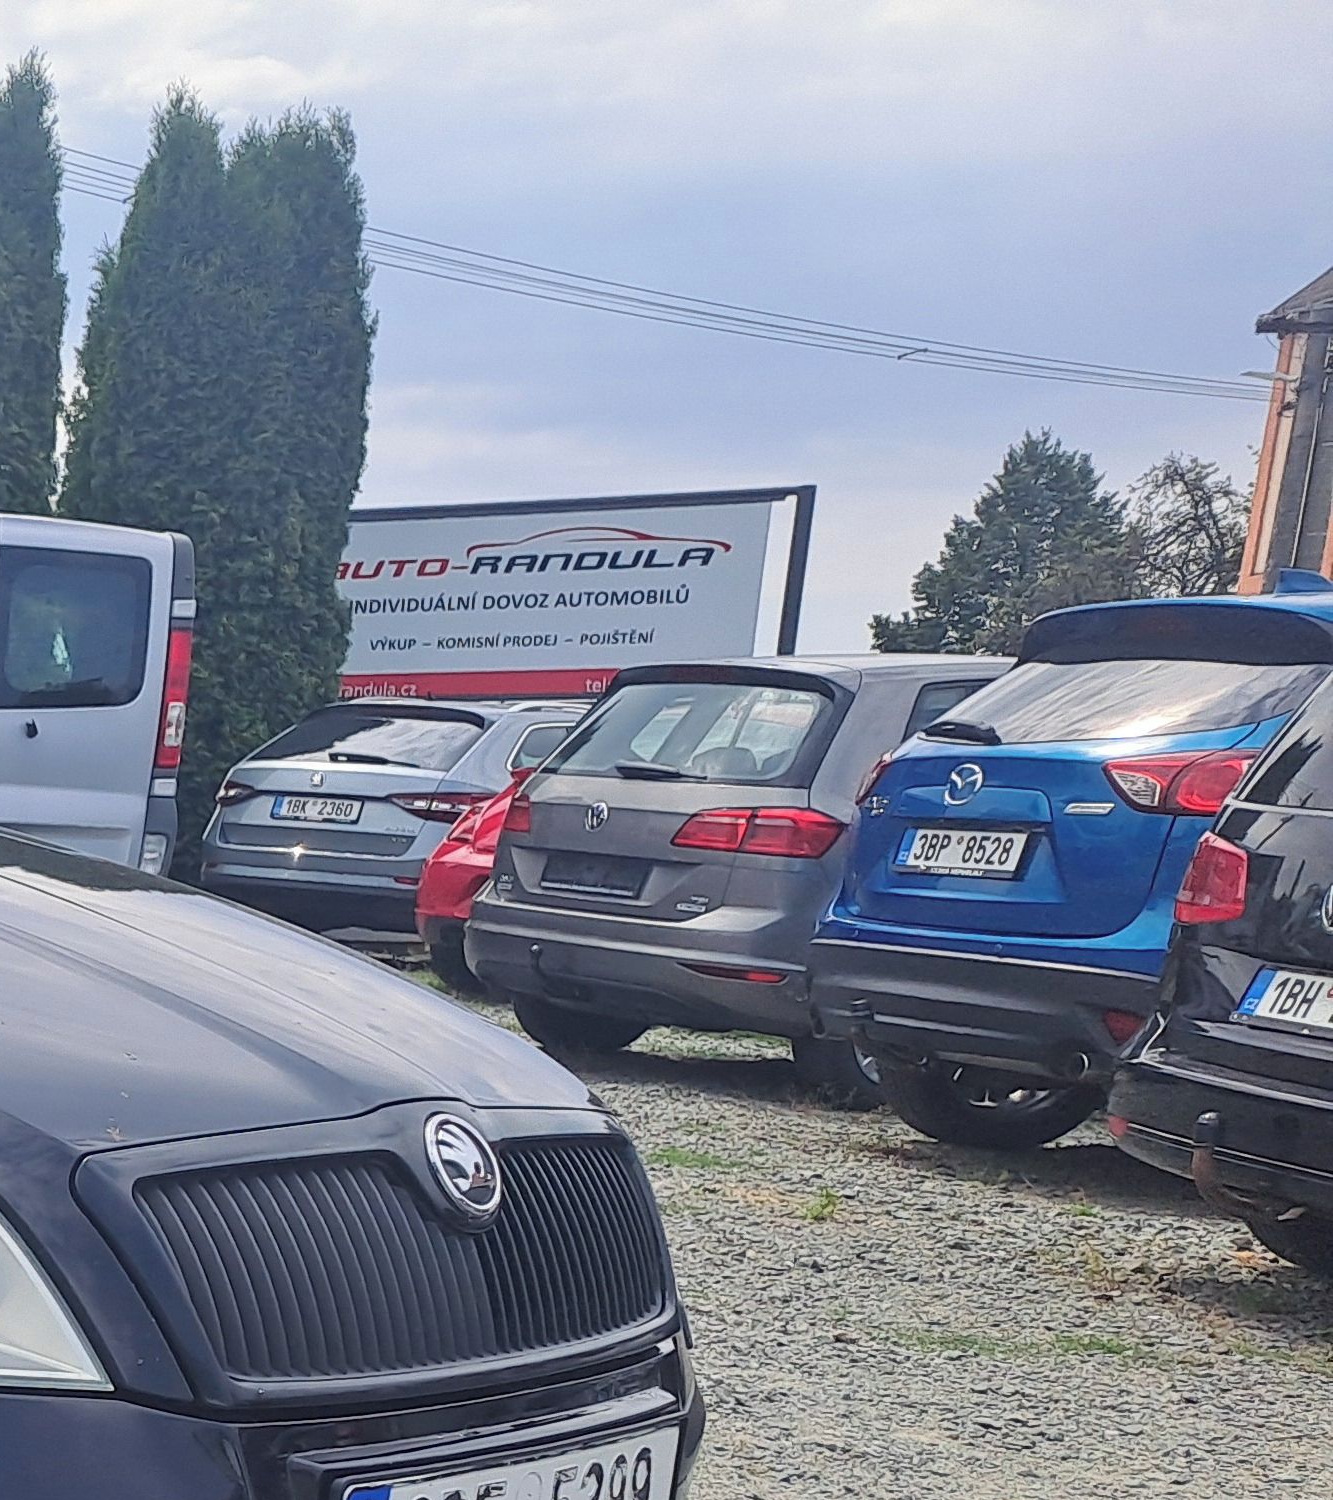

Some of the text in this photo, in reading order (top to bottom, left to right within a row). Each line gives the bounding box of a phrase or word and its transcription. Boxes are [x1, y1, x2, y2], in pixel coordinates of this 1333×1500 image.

[349, 583, 690, 614] INDIVIDUÁLNÍ DOVOZ AUTOMOBILŮ
[370, 636, 417, 651] VÝKUP
[437, 631, 500, 649] KOMISNÍ
[503, 634, 558, 648] PRODEJ
[580, 627, 655, 646] POJIŠTĚNÍ
[286, 799, 310, 815] 1BK
[317, 801, 354, 818] 2360
[913, 833, 1015, 866] 3BP 8528
[1269, 977, 1325, 1019] 1BH
